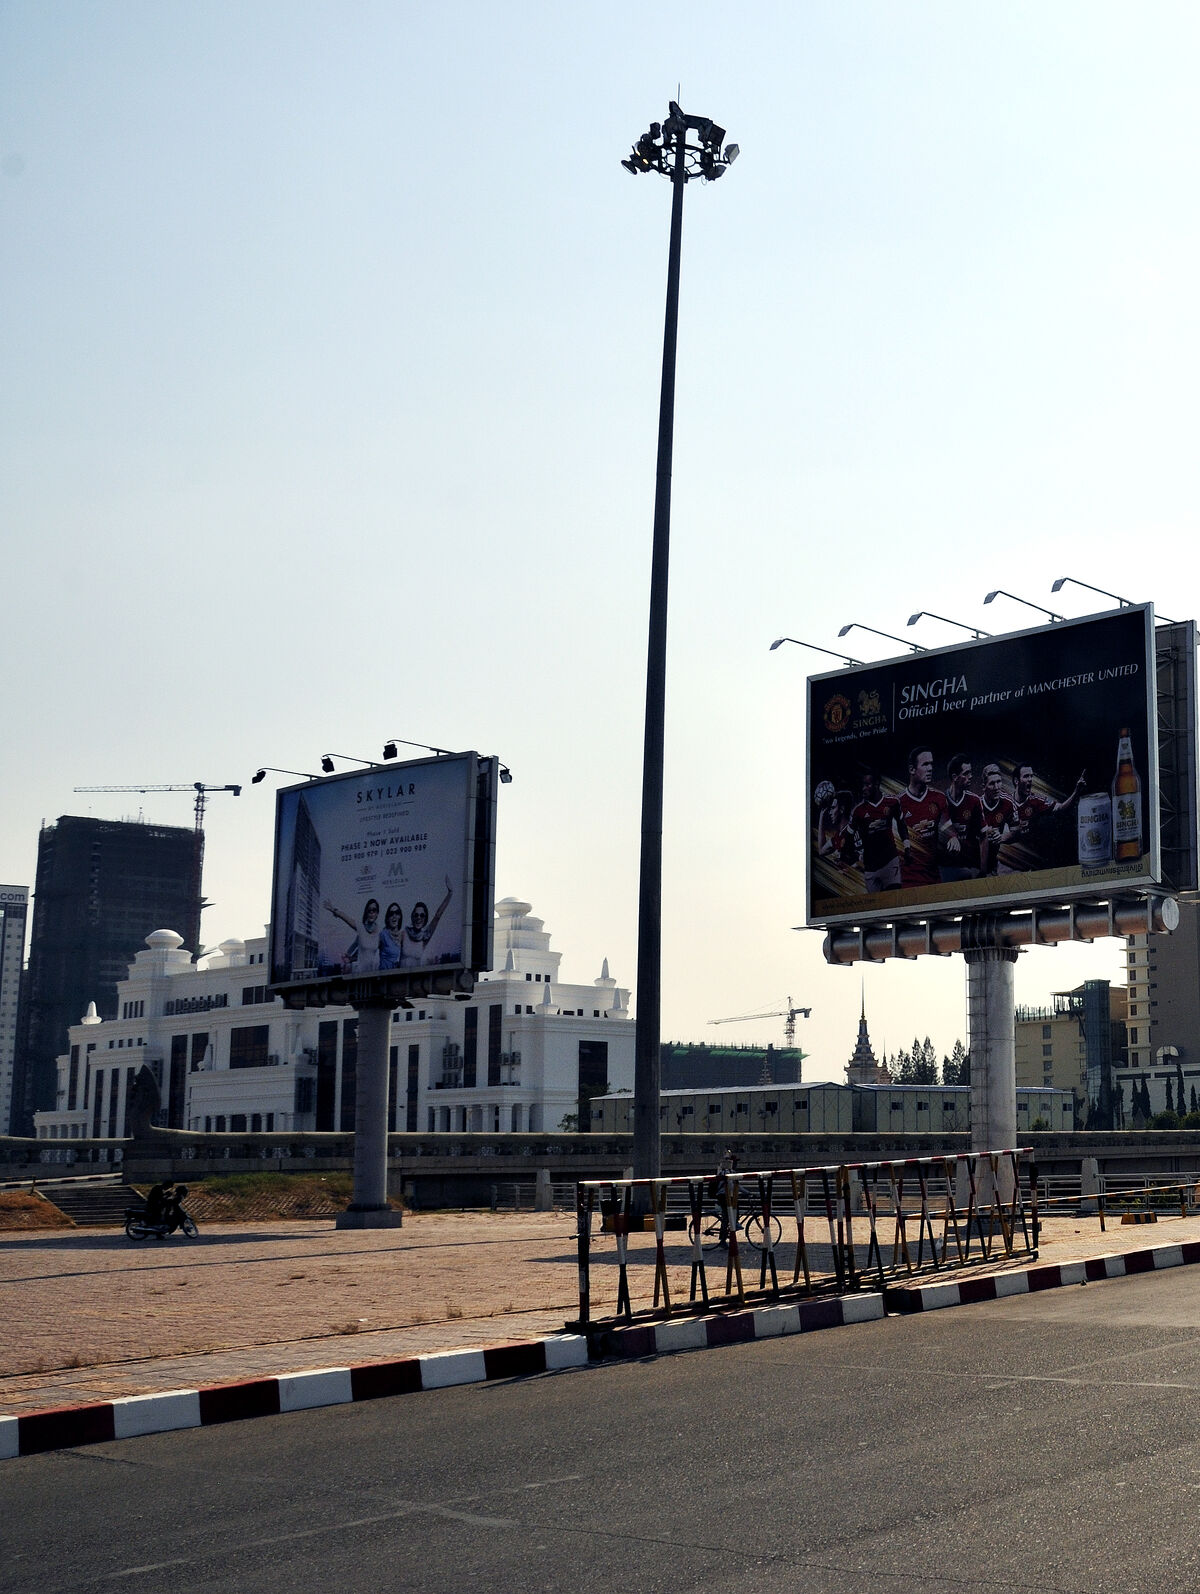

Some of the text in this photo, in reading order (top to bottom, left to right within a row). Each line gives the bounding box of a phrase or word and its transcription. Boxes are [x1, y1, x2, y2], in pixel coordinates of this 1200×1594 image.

[898, 663, 1139, 720] Official beer partner of MANCHESTER UNITED
[900, 674, 968, 704] SINGHA
[852, 714, 888, 729] SINGHA
[356, 783, 416, 804] SKYLAR
[341, 833, 429, 852] PHASE 2 NOW AVAILABLE
